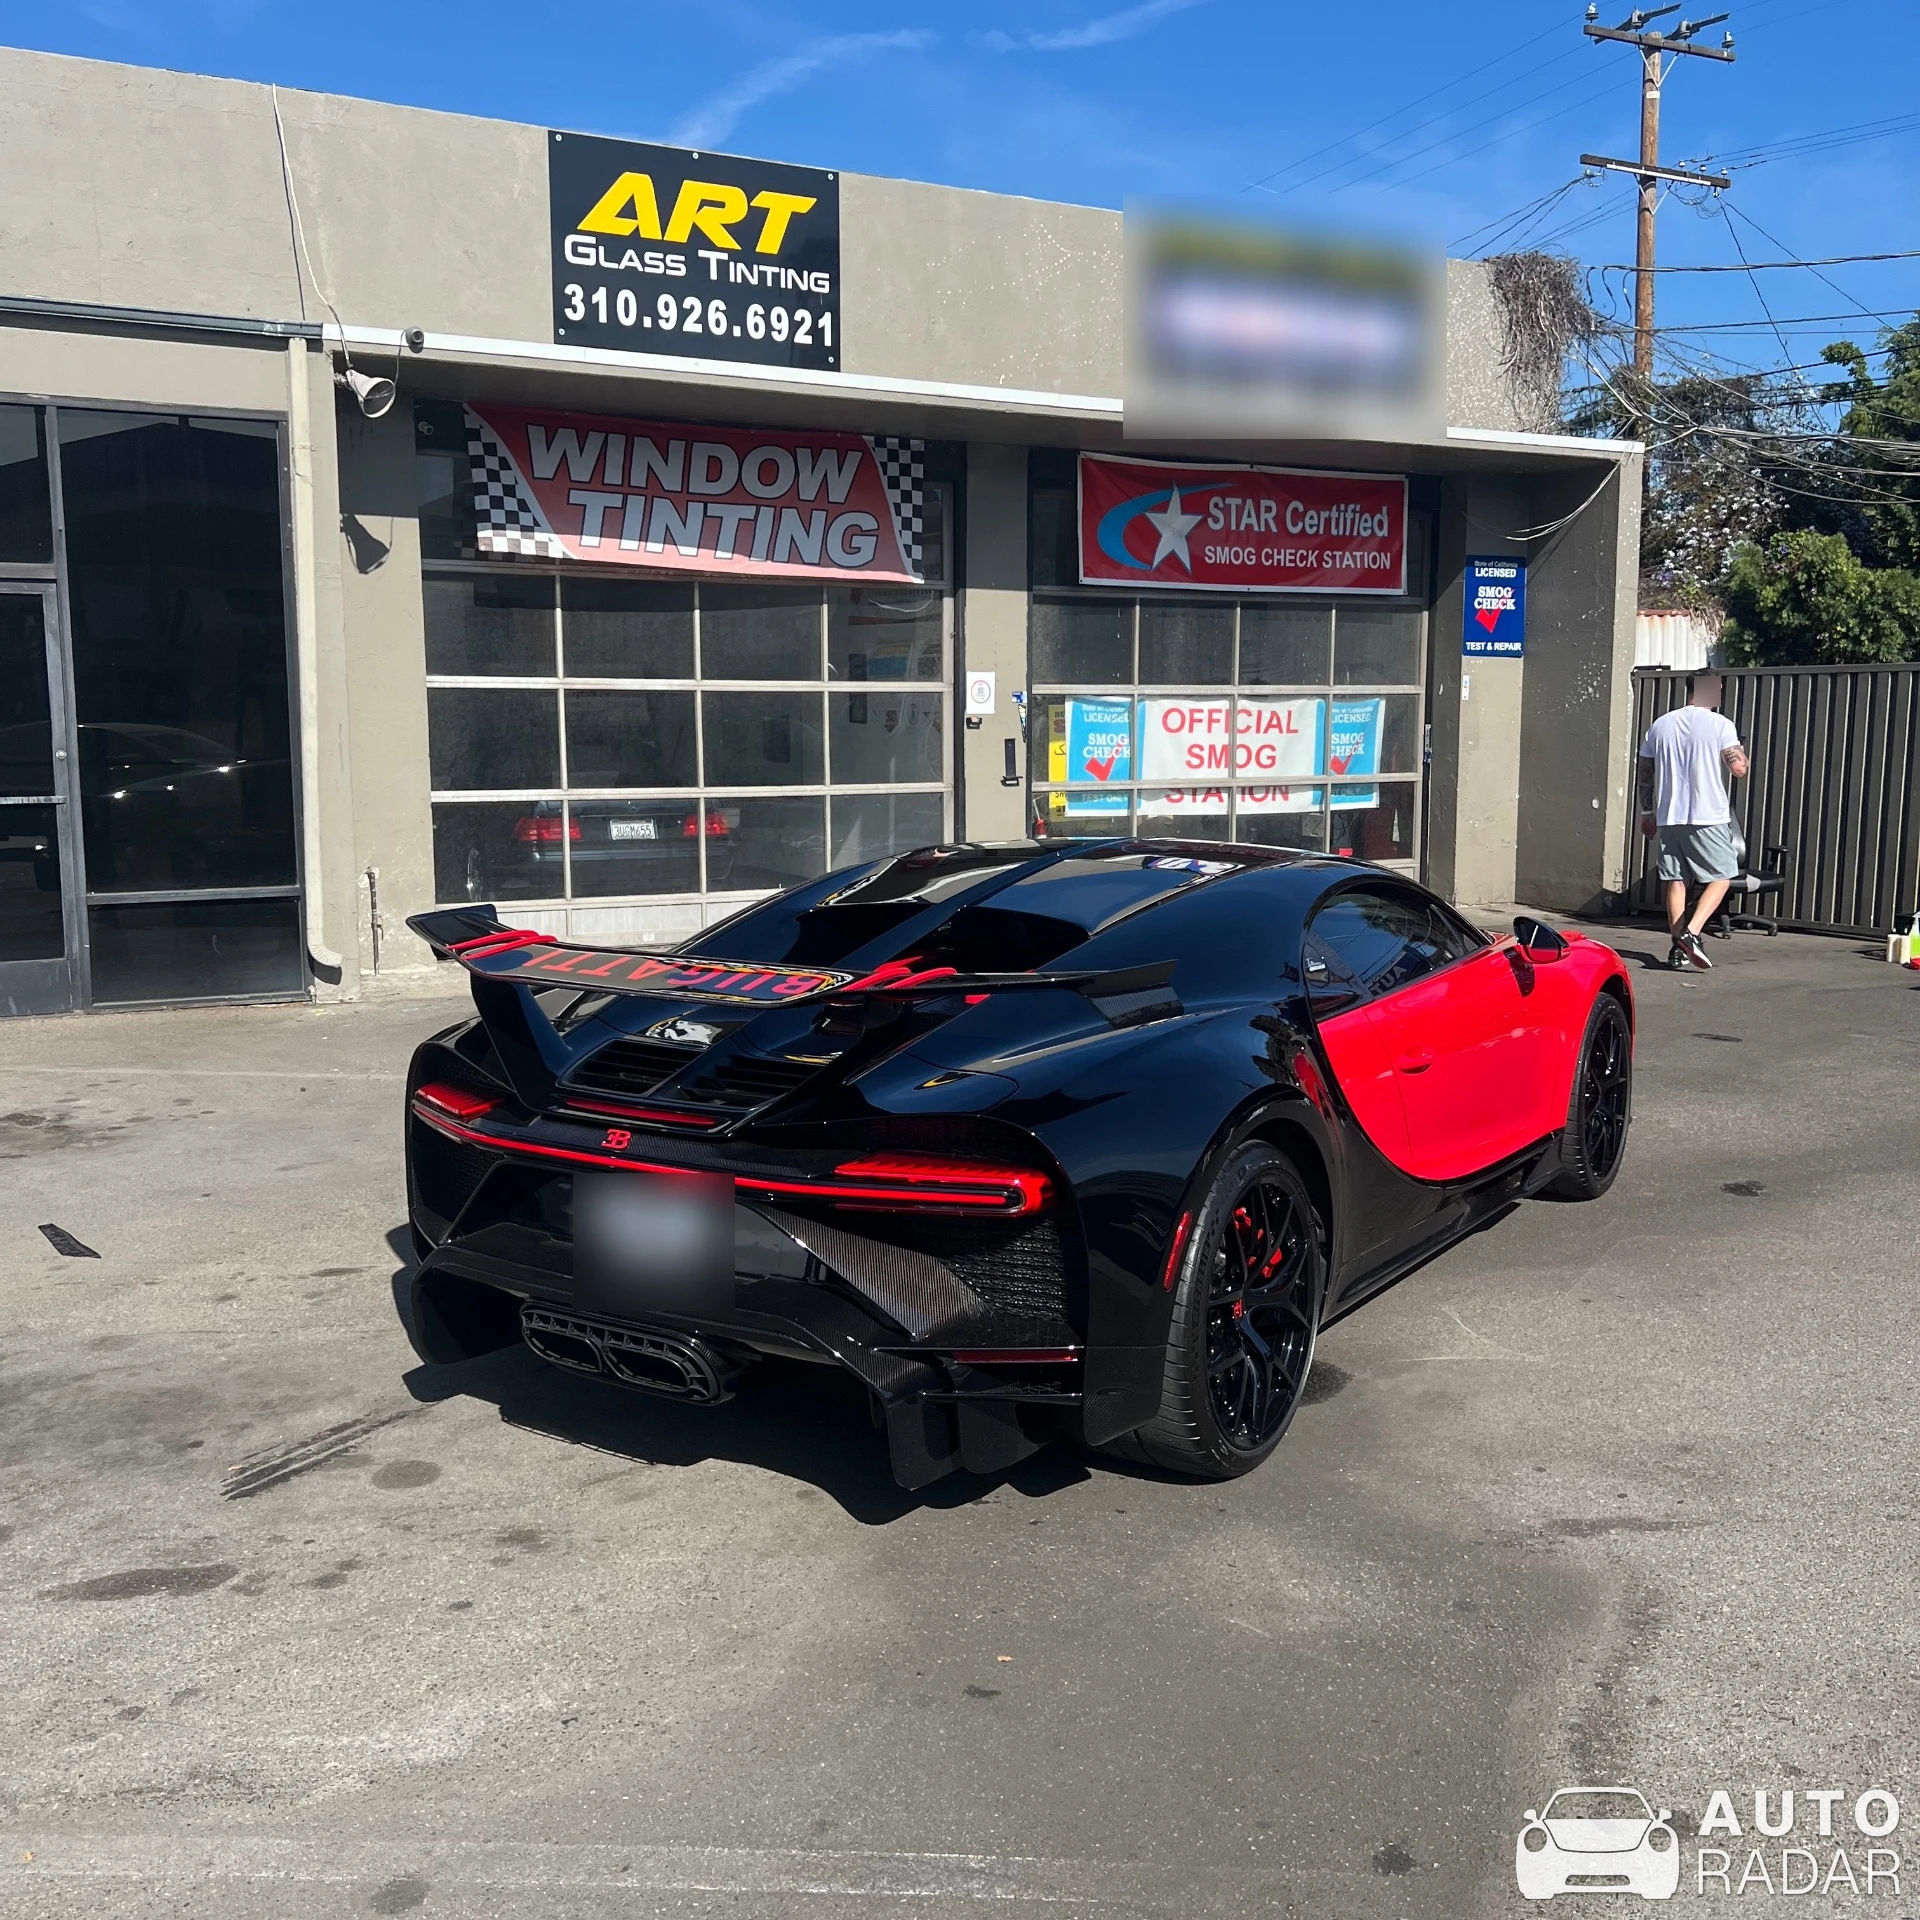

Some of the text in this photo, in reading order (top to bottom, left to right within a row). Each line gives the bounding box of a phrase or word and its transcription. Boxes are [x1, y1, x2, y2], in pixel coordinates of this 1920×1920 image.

[577, 171, 817, 255] ART
[564, 234, 830, 293] GLASS TINTING
[564, 283, 832, 347] 310.926.6921
[526, 424, 863, 503] WINDOW
[568, 489, 879, 568] TINTING
[1207, 496, 1389, 537] STAR Certified
[1204, 545, 1391, 570] SMOG CHECK STATION
[1475, 567, 1517, 578] LICENSED
[1474, 598, 1516, 610] CHECK
[1478, 586, 1512, 598] SMOG
[1466, 642, 1522, 651] TEST & REPAIR
[1162, 707, 1299, 734] OFFICIAL
[1089, 733, 1129, 746] SMOG
[1331, 732, 1364, 744] SMOG
[1186, 744, 1277, 769] SMOG
[1082, 793, 1104, 802] TEST
[522, 949, 819, 995] BUGATTI
